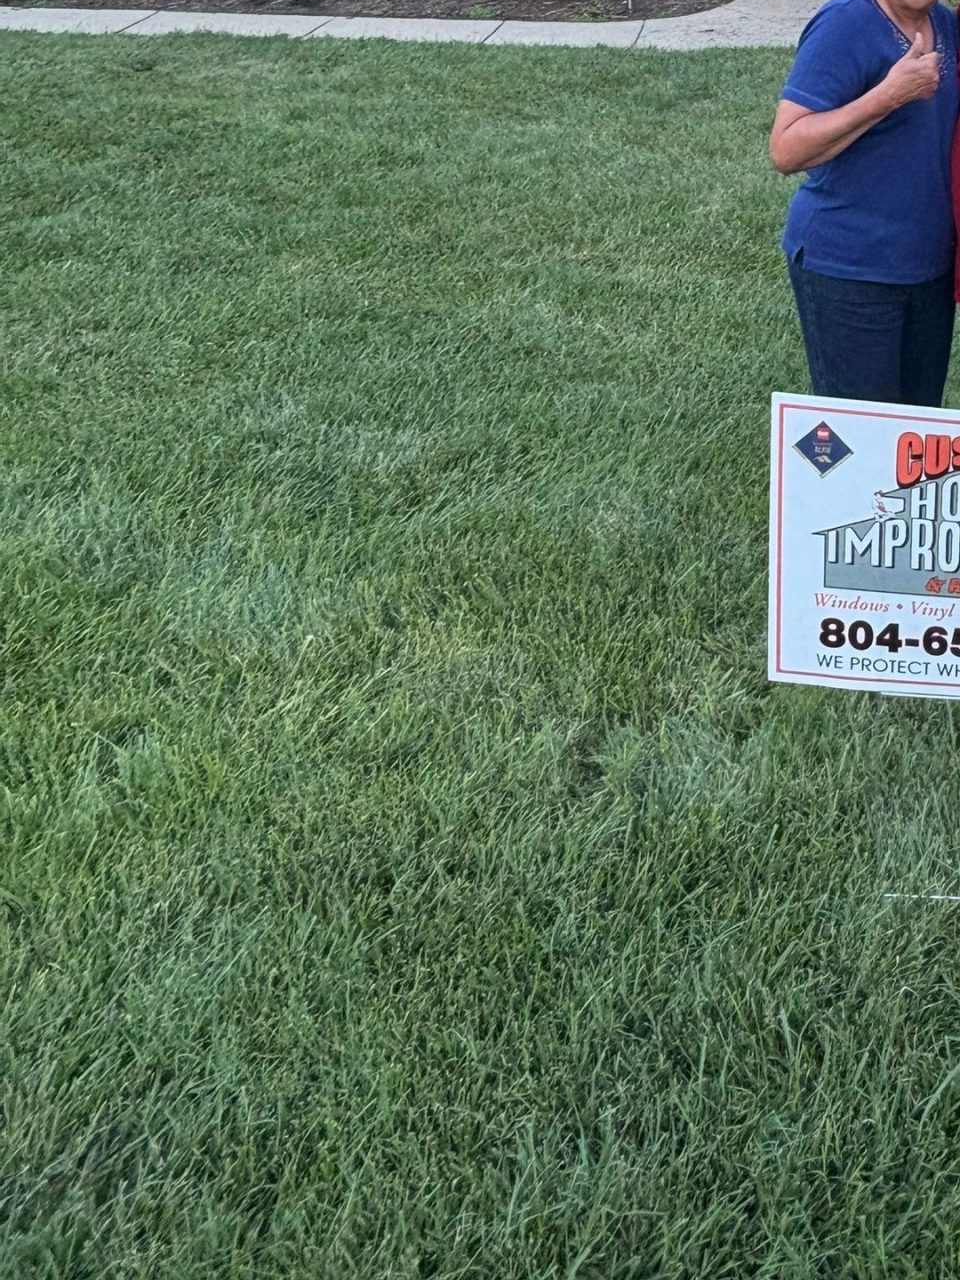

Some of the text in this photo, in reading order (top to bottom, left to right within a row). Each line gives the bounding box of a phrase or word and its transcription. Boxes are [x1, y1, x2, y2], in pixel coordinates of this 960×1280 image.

[925, 576, 944, 592] &
[813, 592, 890, 613] Windows
[909, 601, 955, 622] Vinyl
[816, 654, 844, 670] WE
[849, 657, 931, 675] PROTECT
